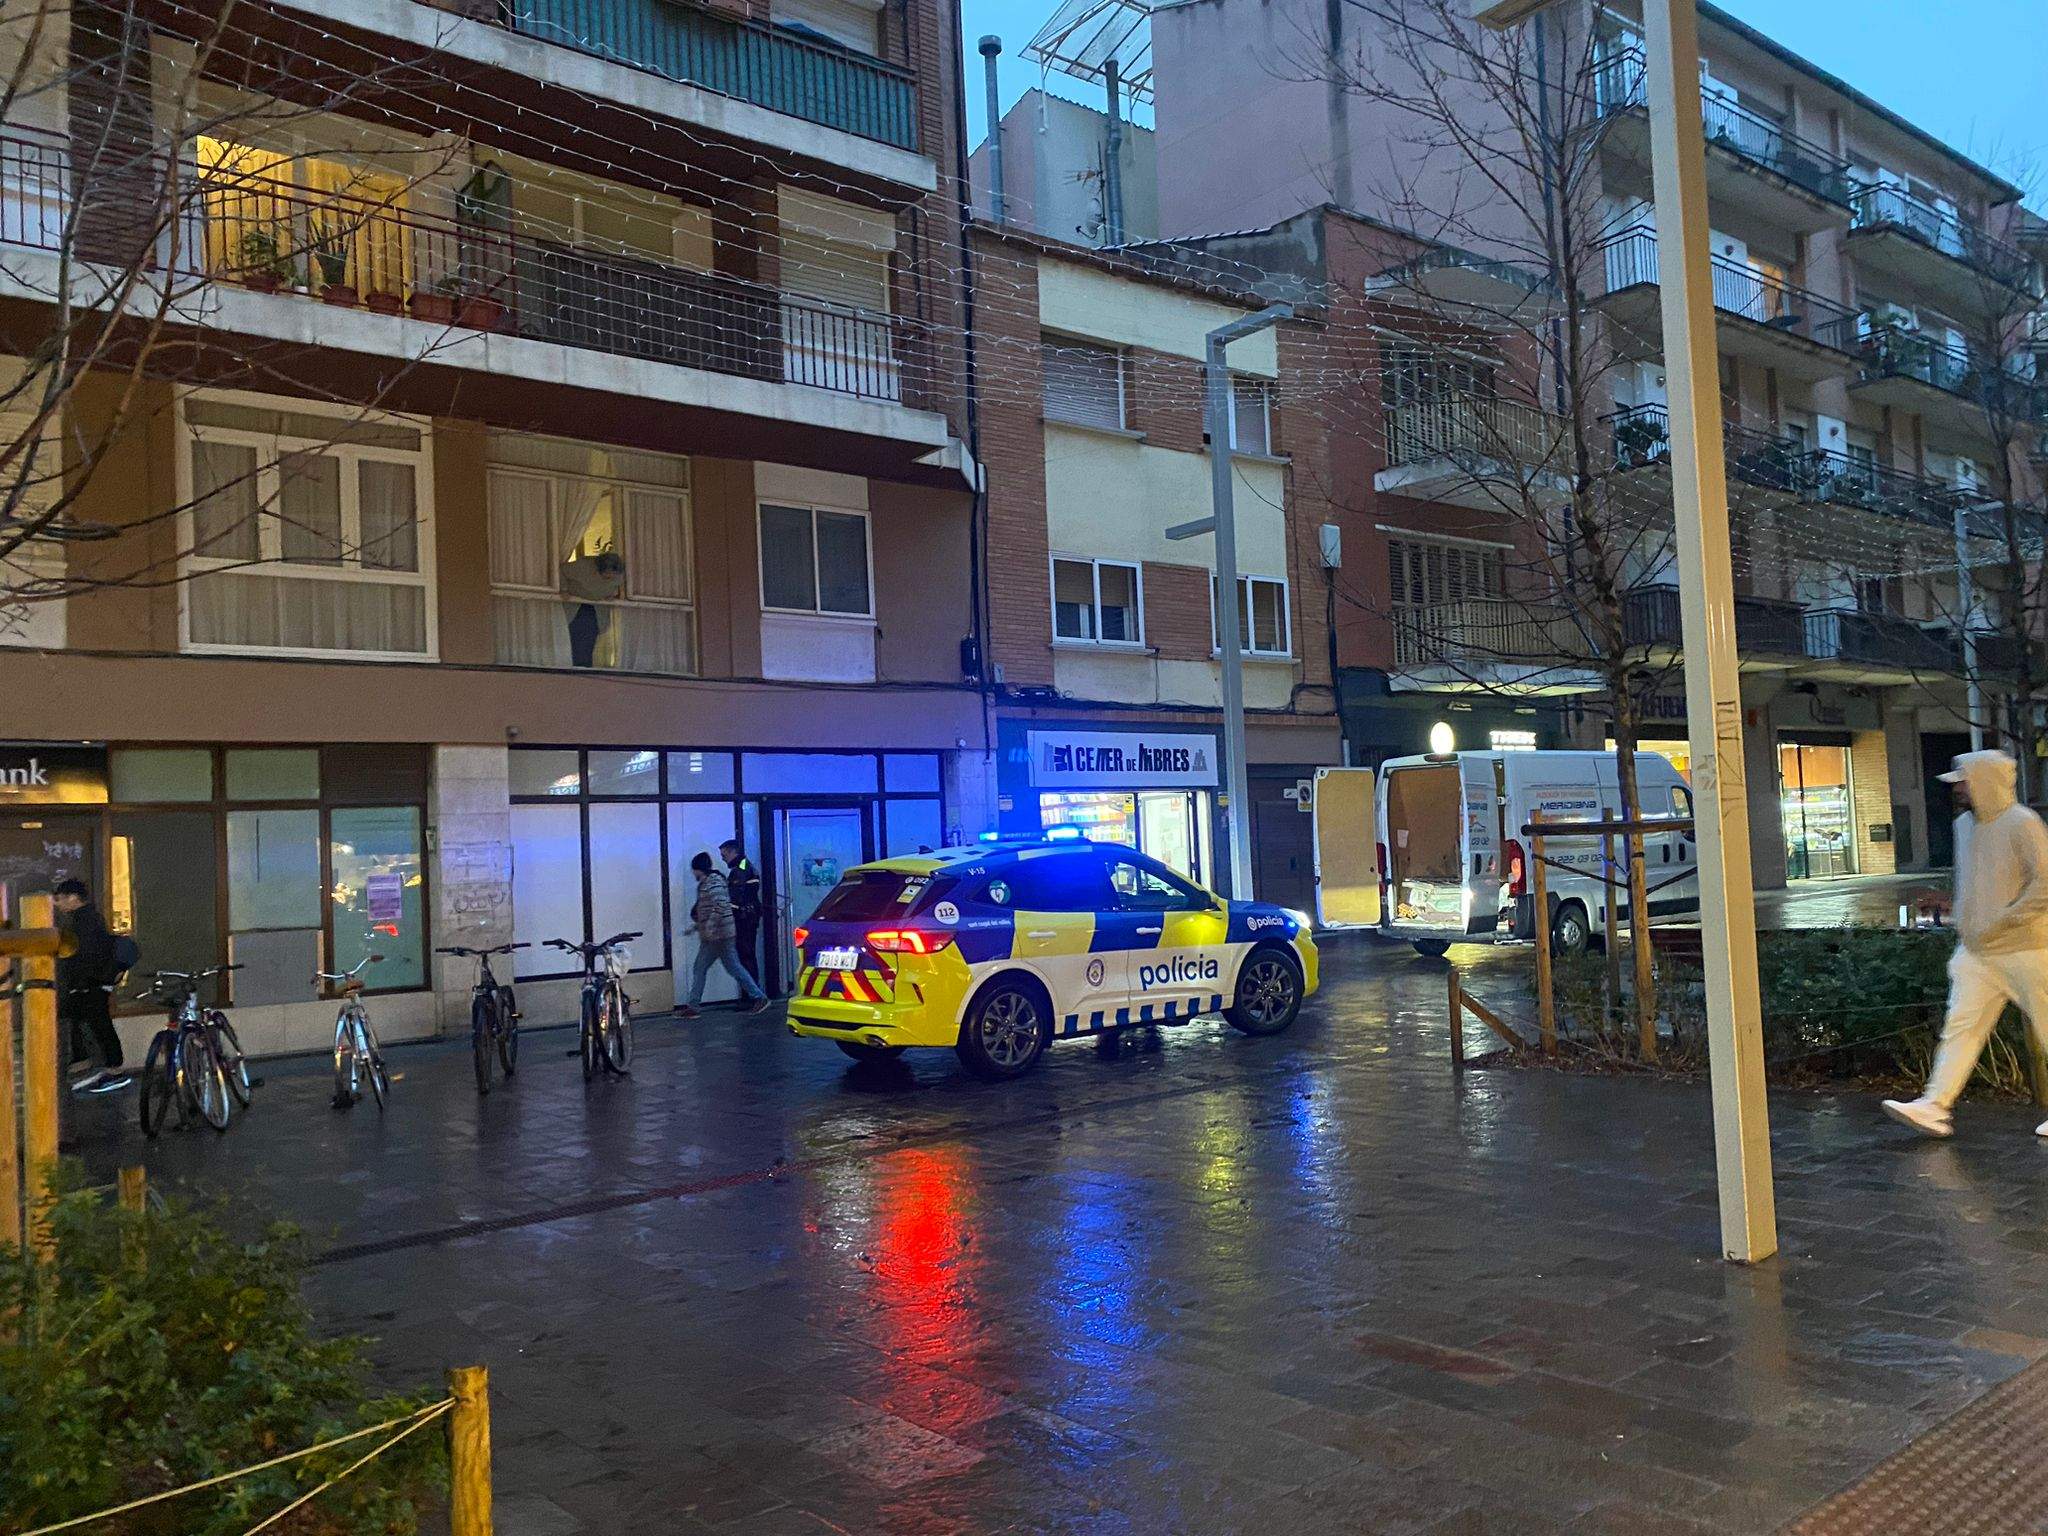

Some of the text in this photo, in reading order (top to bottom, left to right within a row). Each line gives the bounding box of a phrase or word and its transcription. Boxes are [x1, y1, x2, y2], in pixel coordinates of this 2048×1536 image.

[1126, 758, 1137, 772] DE
[938, 907, 955, 918] 112
[1257, 915, 1284, 929] policia
[1139, 953, 1219, 991] policia
